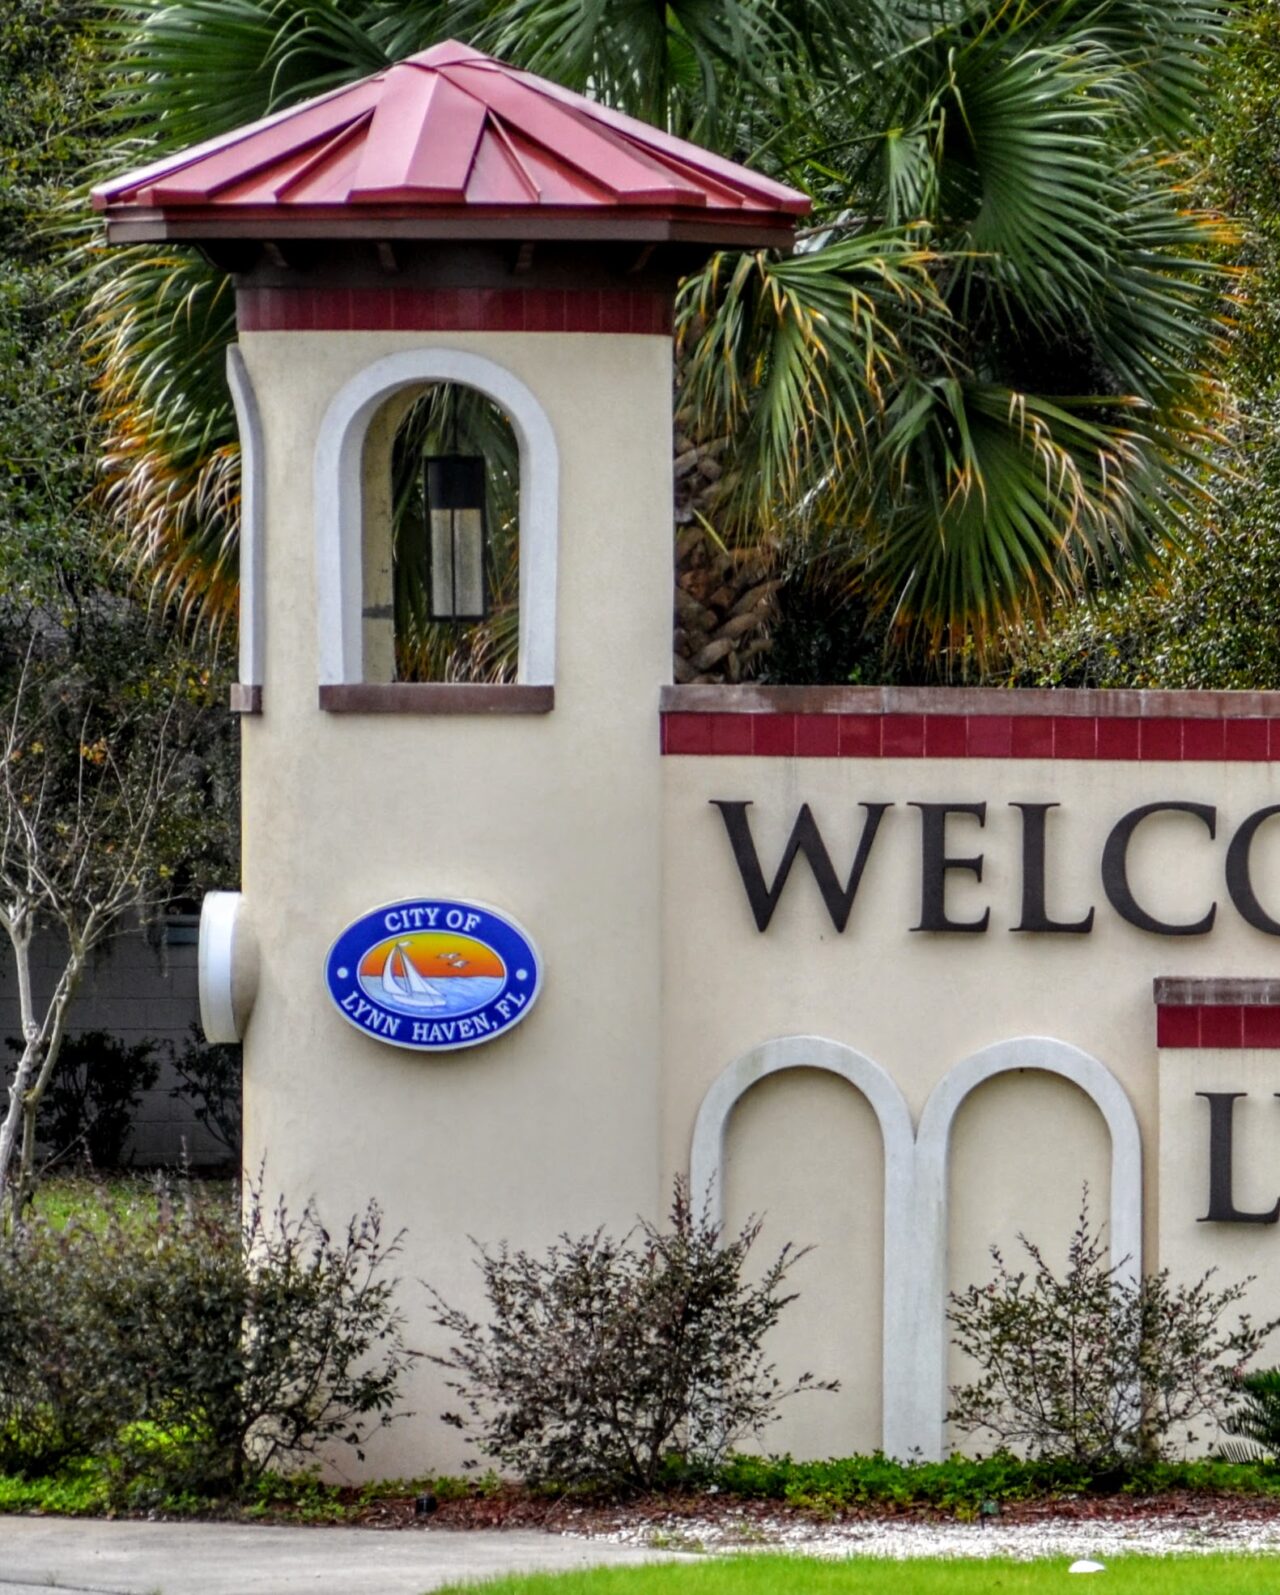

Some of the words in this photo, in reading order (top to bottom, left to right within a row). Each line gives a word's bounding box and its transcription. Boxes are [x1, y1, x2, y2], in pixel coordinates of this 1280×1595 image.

[384, 907, 440, 932] CITY
[446, 909, 482, 933] OF
[341, 991, 402, 1037] LYNN
[411, 1012, 499, 1042] HAVEN,
[494, 991, 527, 1019] FL
